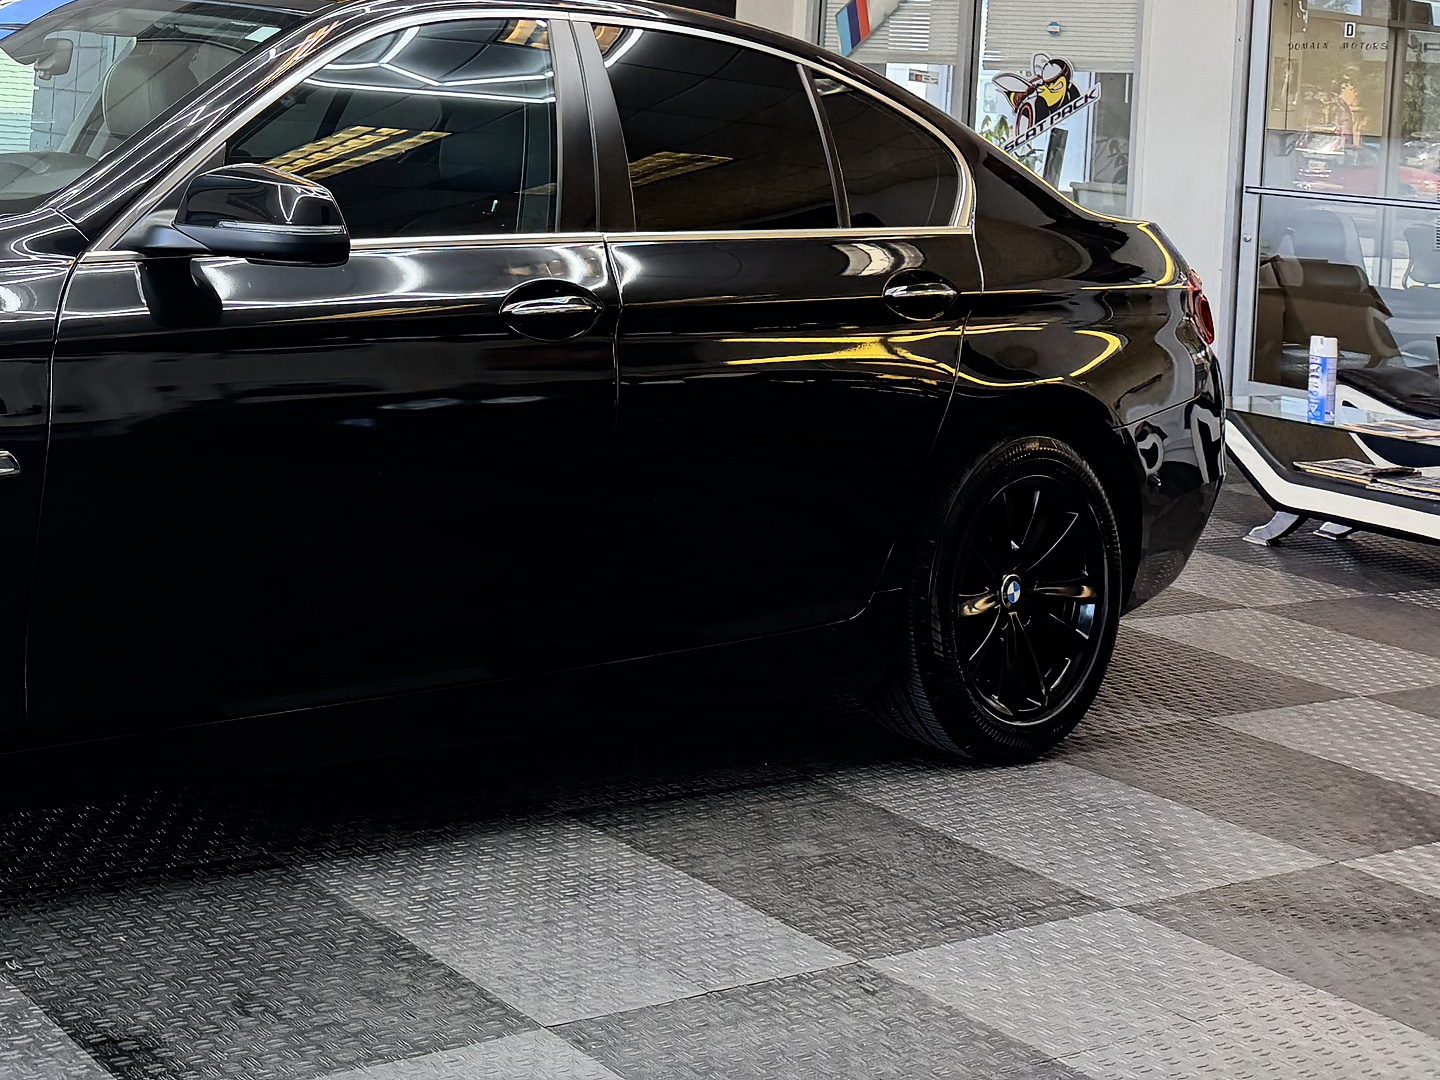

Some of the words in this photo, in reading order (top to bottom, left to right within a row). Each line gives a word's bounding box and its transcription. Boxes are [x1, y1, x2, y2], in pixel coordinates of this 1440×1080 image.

[1288, 42, 1329, 51] DOMAIN
[1340, 41, 1388, 51] MOTORS
[1003, 120, 1048, 151] SCAT
[1050, 88, 1097, 126] PACK
